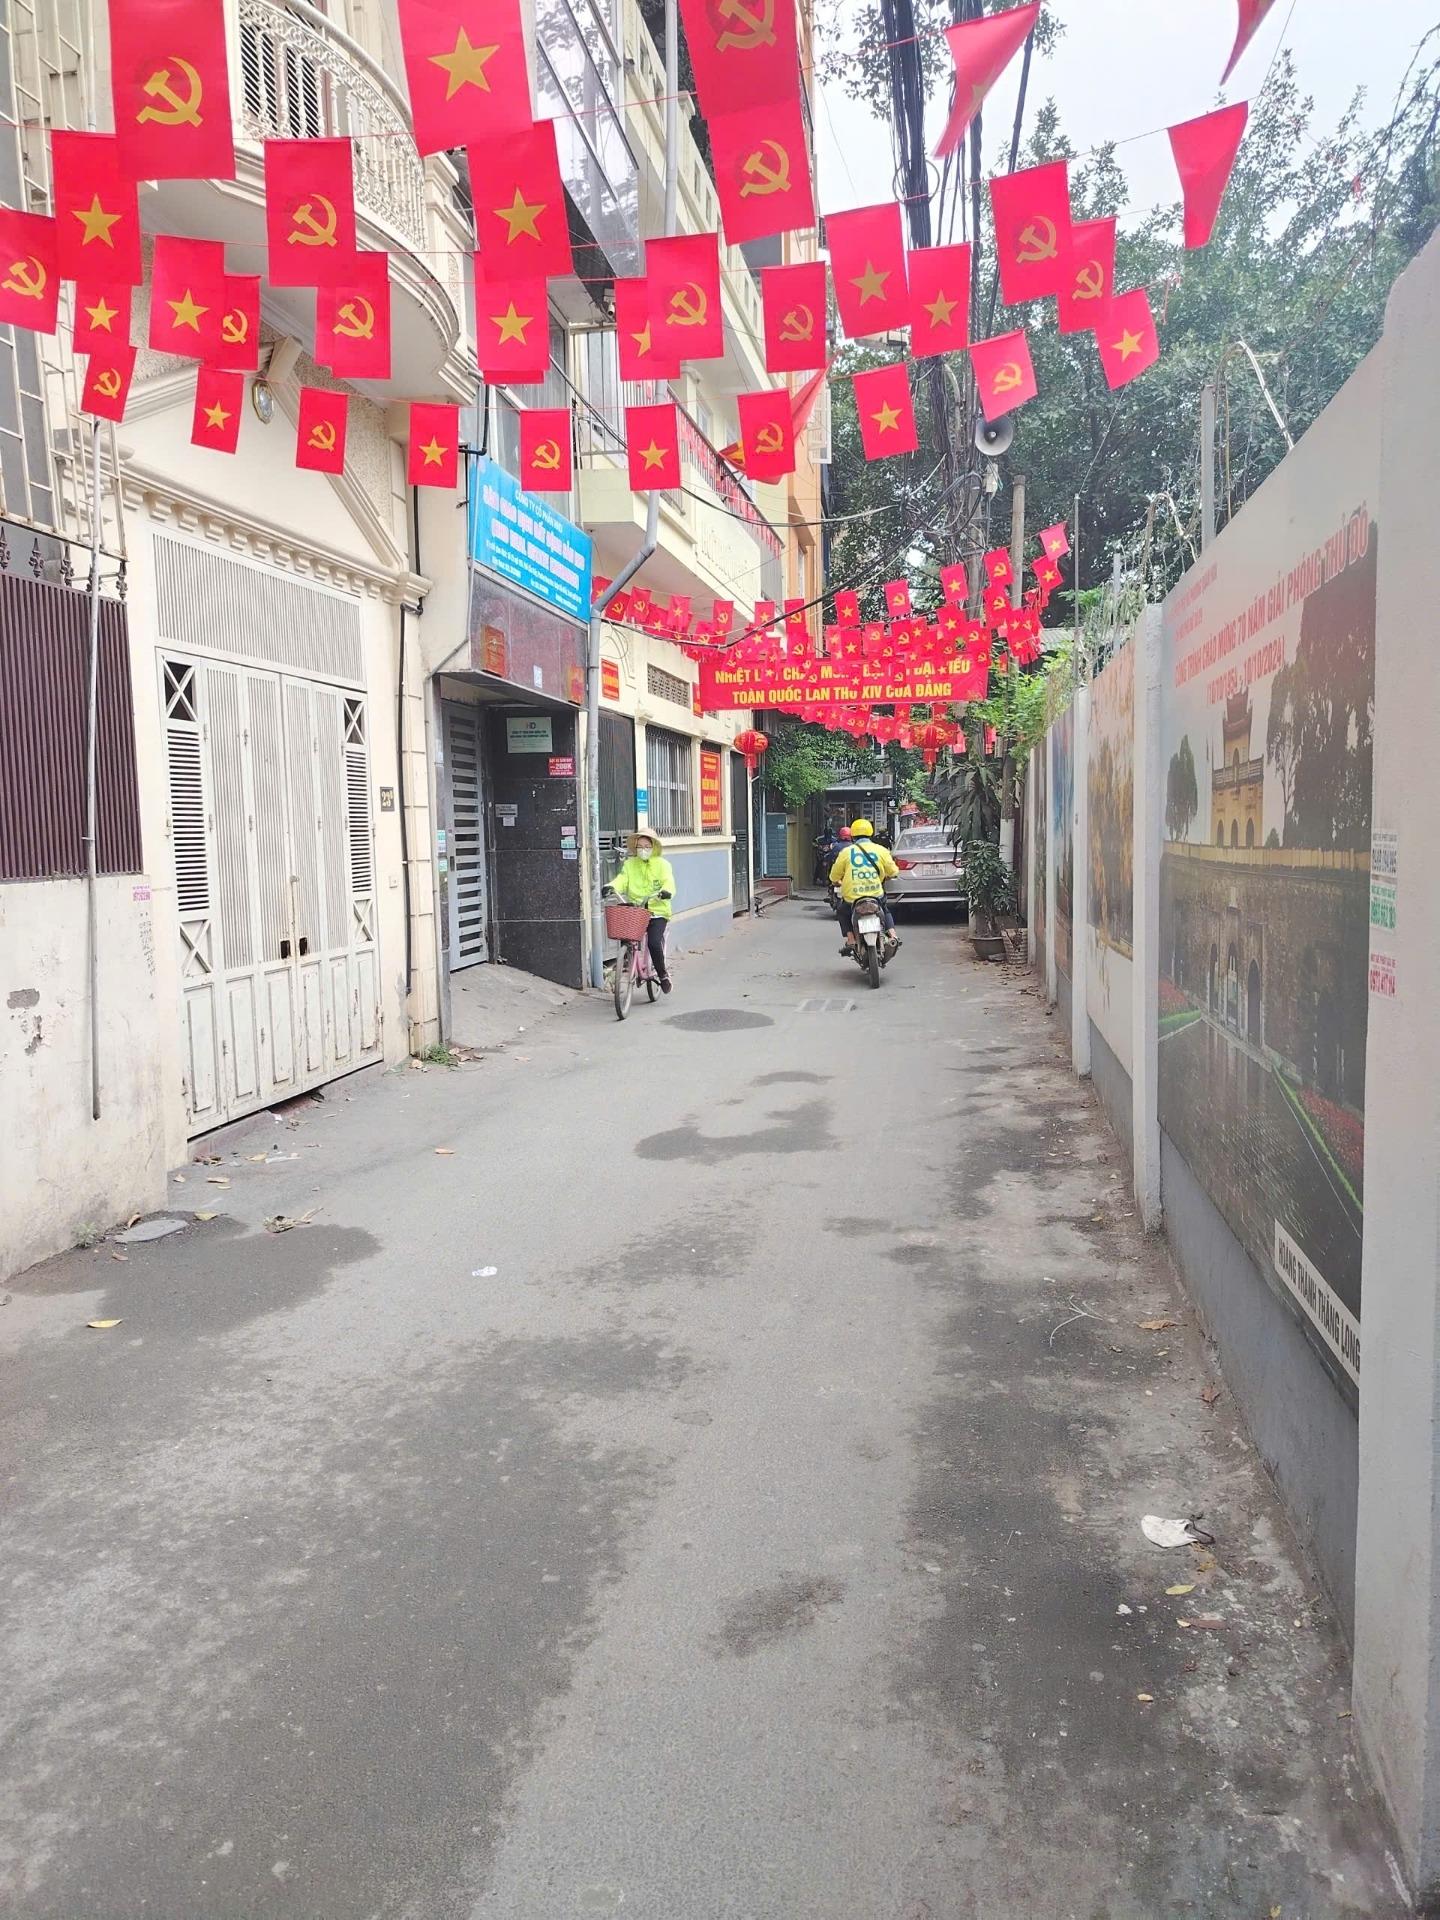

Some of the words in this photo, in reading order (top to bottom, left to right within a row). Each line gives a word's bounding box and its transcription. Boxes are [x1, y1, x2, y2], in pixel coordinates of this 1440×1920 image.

[1237, 612, 1246, 646] 70
[1286, 548, 1321, 609] PHÓNG
[946, 655, 971, 675] IỂU
[732, 688, 765, 705] TOÀN
[769, 685, 802, 704] QUỐC
[862, 685, 882, 699] XIV
[915, 678, 952, 697] ĐẢNG
[1340, 1319, 1361, 1374] LONG
